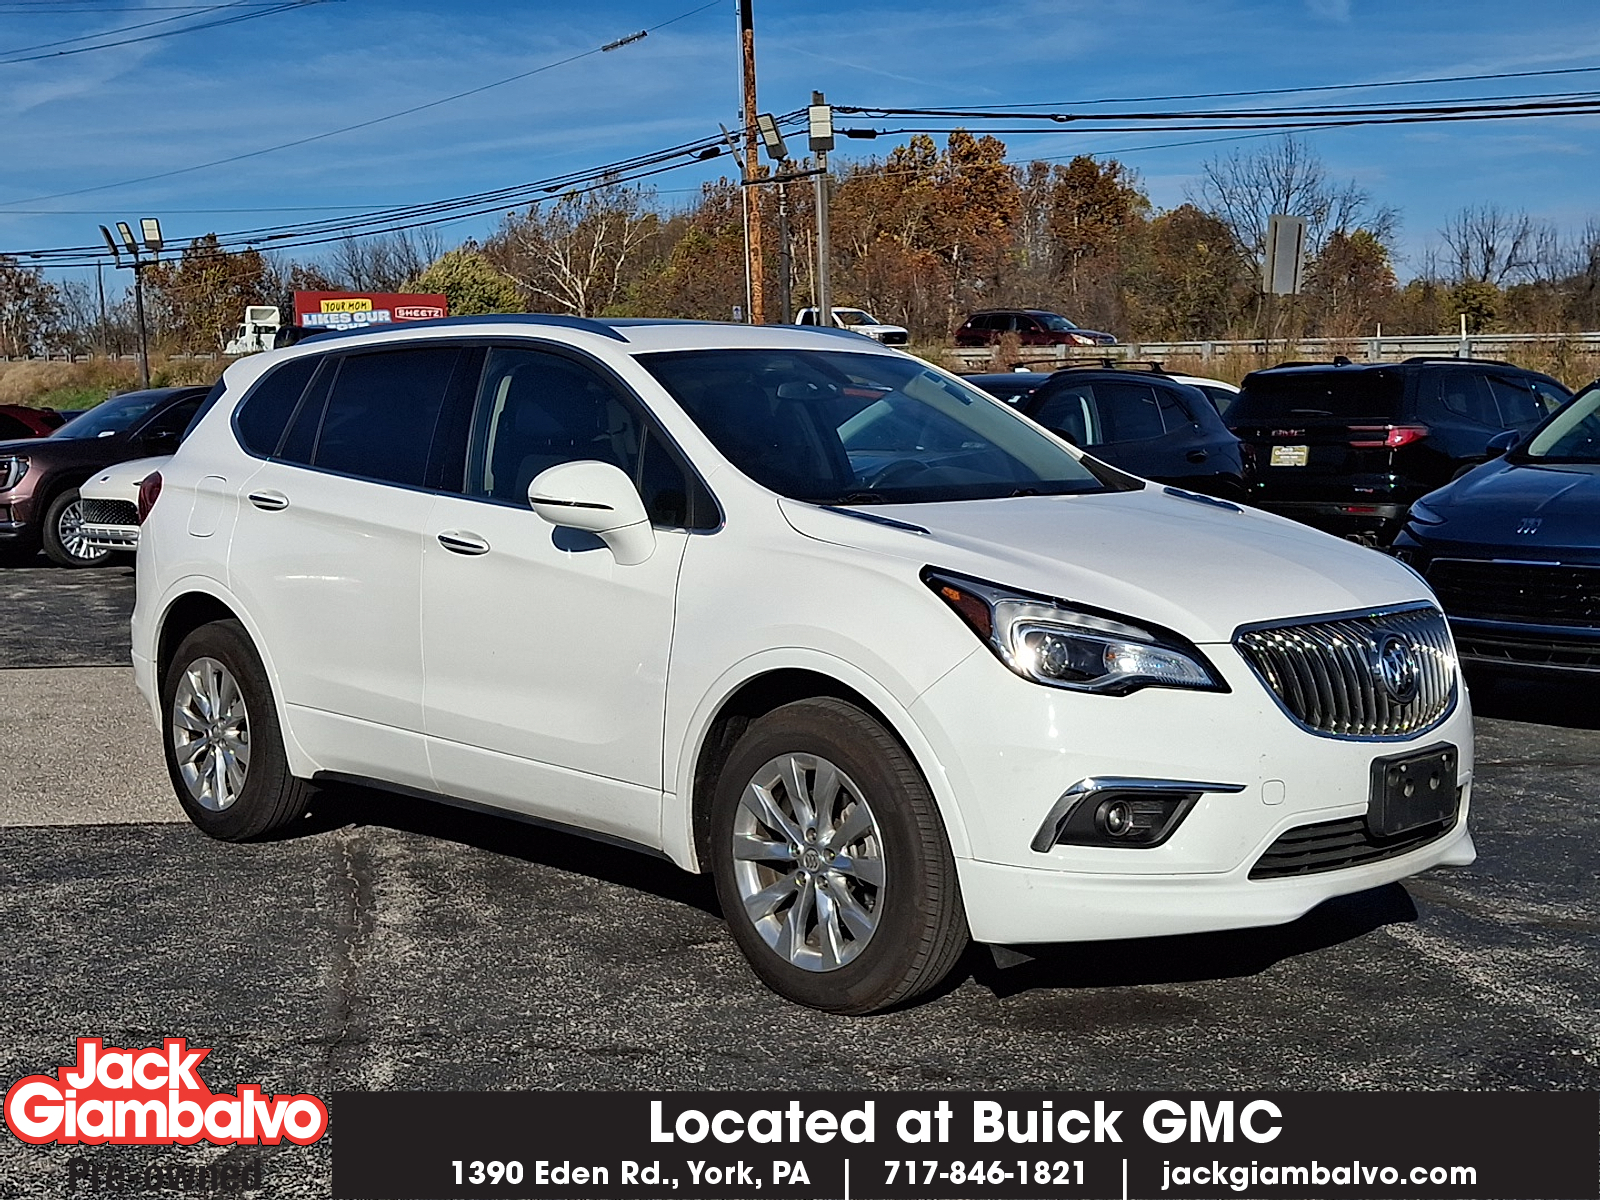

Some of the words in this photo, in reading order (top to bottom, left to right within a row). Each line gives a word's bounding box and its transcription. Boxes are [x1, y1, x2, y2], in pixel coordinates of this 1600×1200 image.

[325, 301, 346, 311] YOUR
[348, 301, 367, 310] MOM
[302, 312, 352, 325] LIKES
[353, 310, 392, 323] OUR
